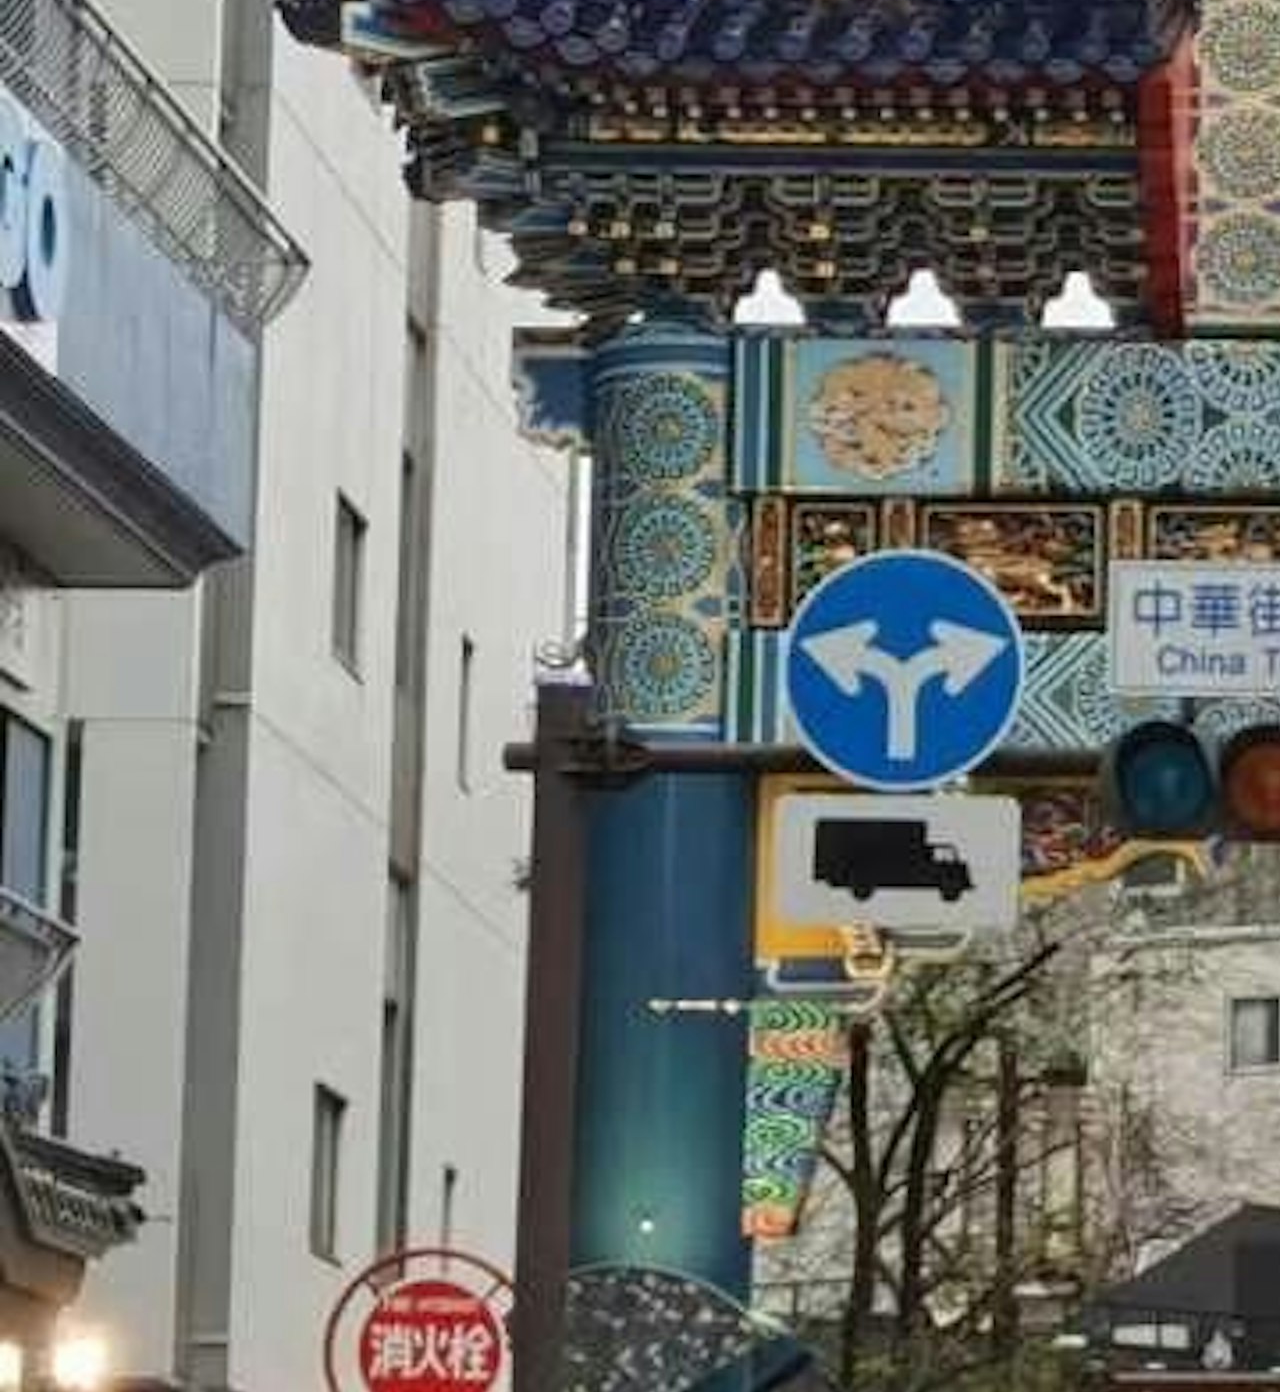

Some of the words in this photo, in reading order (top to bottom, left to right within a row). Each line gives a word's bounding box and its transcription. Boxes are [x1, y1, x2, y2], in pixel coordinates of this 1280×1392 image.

[1157, 645, 1246, 676] China
[369, 1323, 492, 1380] 消火栓
